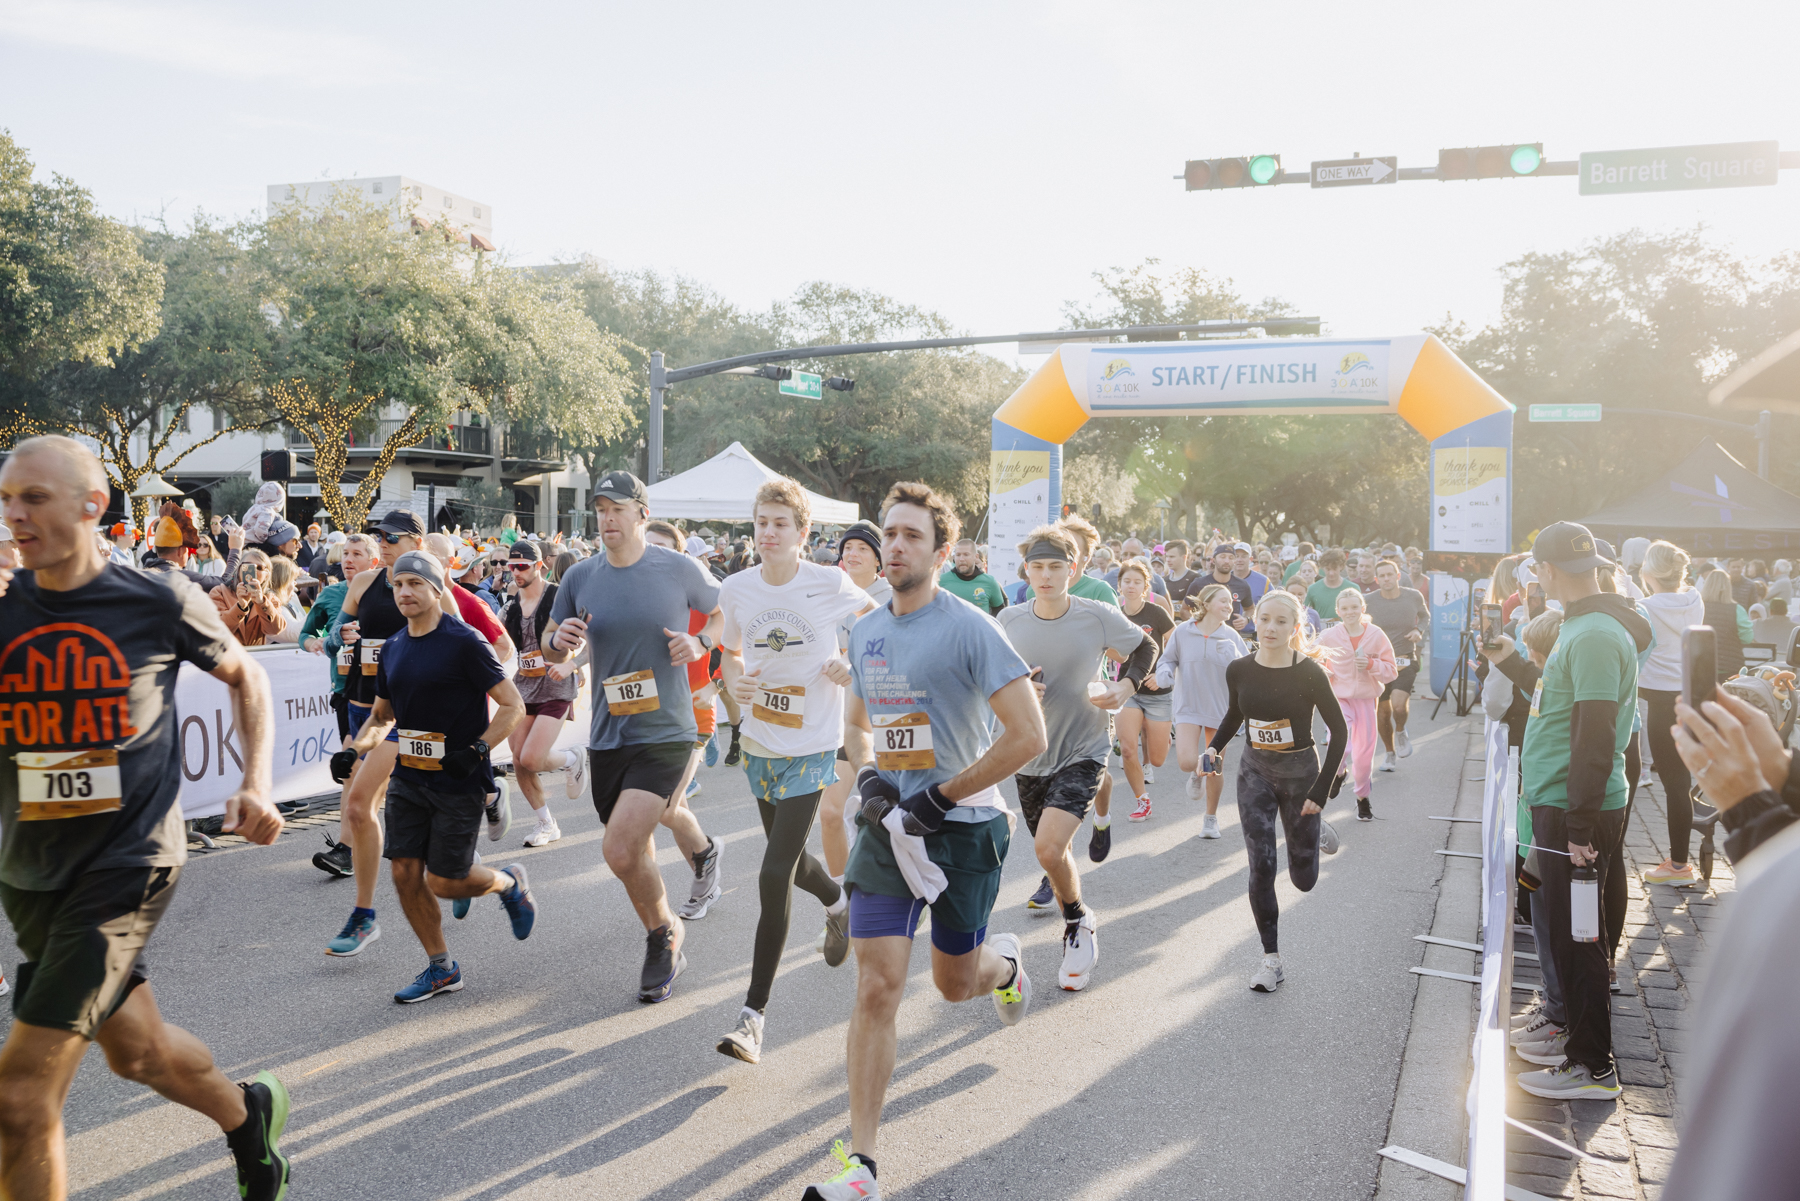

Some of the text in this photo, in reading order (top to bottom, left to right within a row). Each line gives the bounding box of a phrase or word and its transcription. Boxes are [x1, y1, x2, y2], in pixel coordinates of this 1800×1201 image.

[1320, 166, 1371, 180] ONE WAY
[1590, 156, 1766, 184] Barrett Square
[1122, 383, 1140, 393] 10K
[1359, 377, 1378, 388] 10K
[1533, 407, 1598, 419] Barrett Square
[1022, 464, 1044, 479] you
[1443, 458, 1501, 477] thank you
[762, 610, 786, 623] CROSS
[787, 613, 817, 644] COUNTRY
[875, 667, 890, 675] FUN
[875, 675, 885, 683] MY
[886, 674, 907, 682] HEALTH
[617, 682, 645, 701] 182
[876, 682, 911, 690] COMMUNITY
[764, 691, 790, 712] 749
[877, 690, 890, 698] THE
[890, 690, 927, 698] CHALLENGE
[916, 697, 934, 705] 2018
[0, 695, 138, 746] FOR ATL
[886, 728, 914, 750] 827
[1258, 729, 1282, 743] 934
[289, 727, 335, 767] 10K
[409, 740, 433, 758] 186
[42, 771, 93, 800] 703
